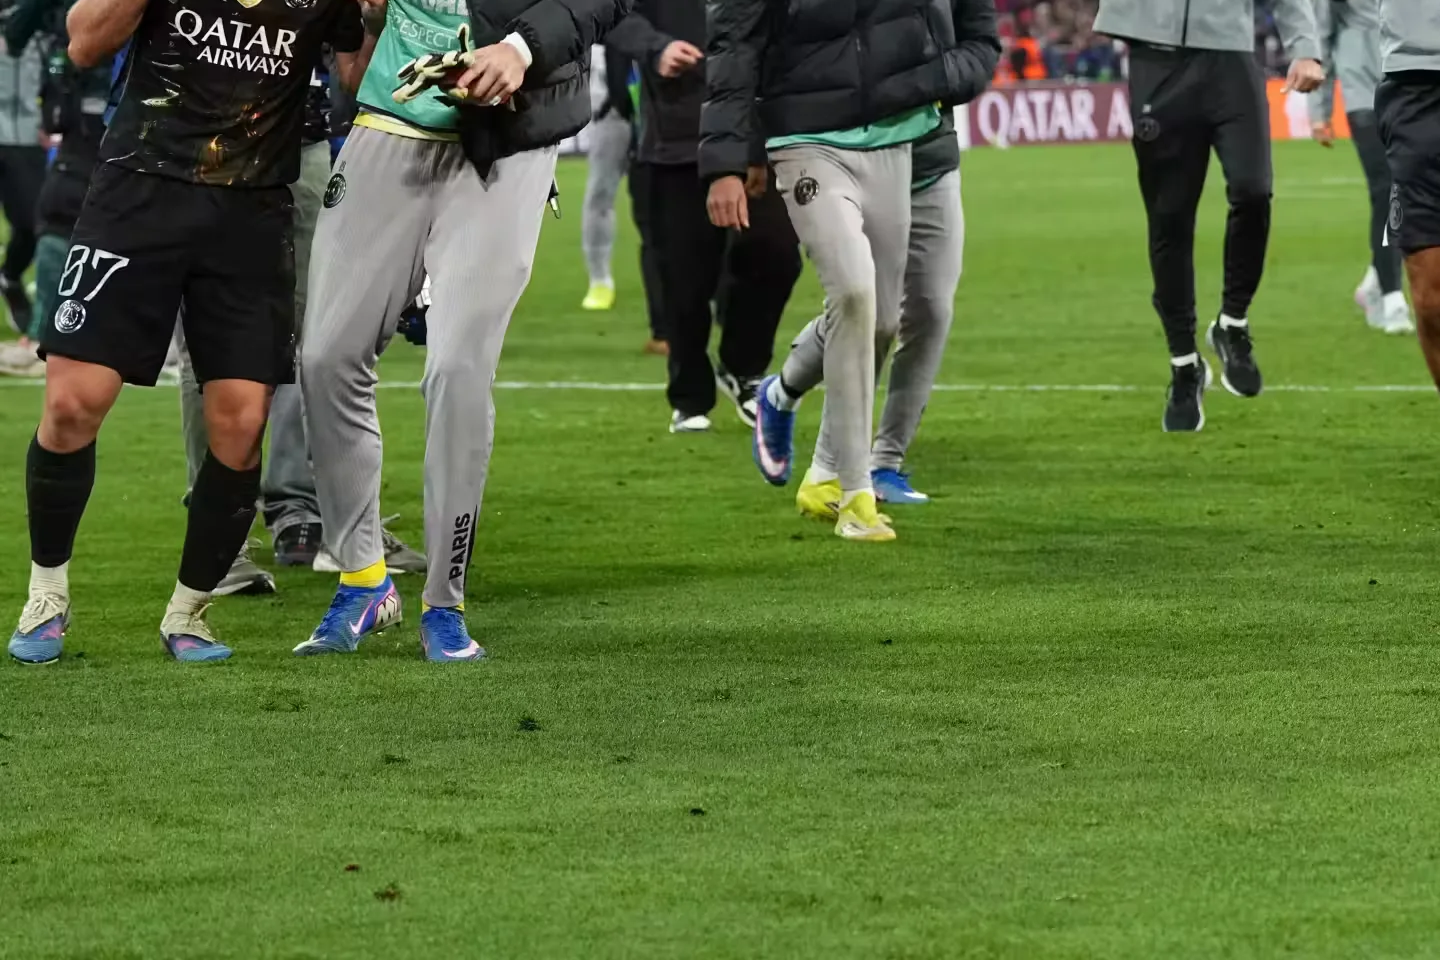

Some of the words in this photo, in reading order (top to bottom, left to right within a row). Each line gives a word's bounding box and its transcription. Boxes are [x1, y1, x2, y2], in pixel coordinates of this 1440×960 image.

[174, 8, 298, 59] QATAR
[196, 44, 291, 77] AIRWAYS
[977, 90, 1098, 150] QATAR
[58, 244, 131, 302] 87
[448, 512, 471, 581] PARIS
